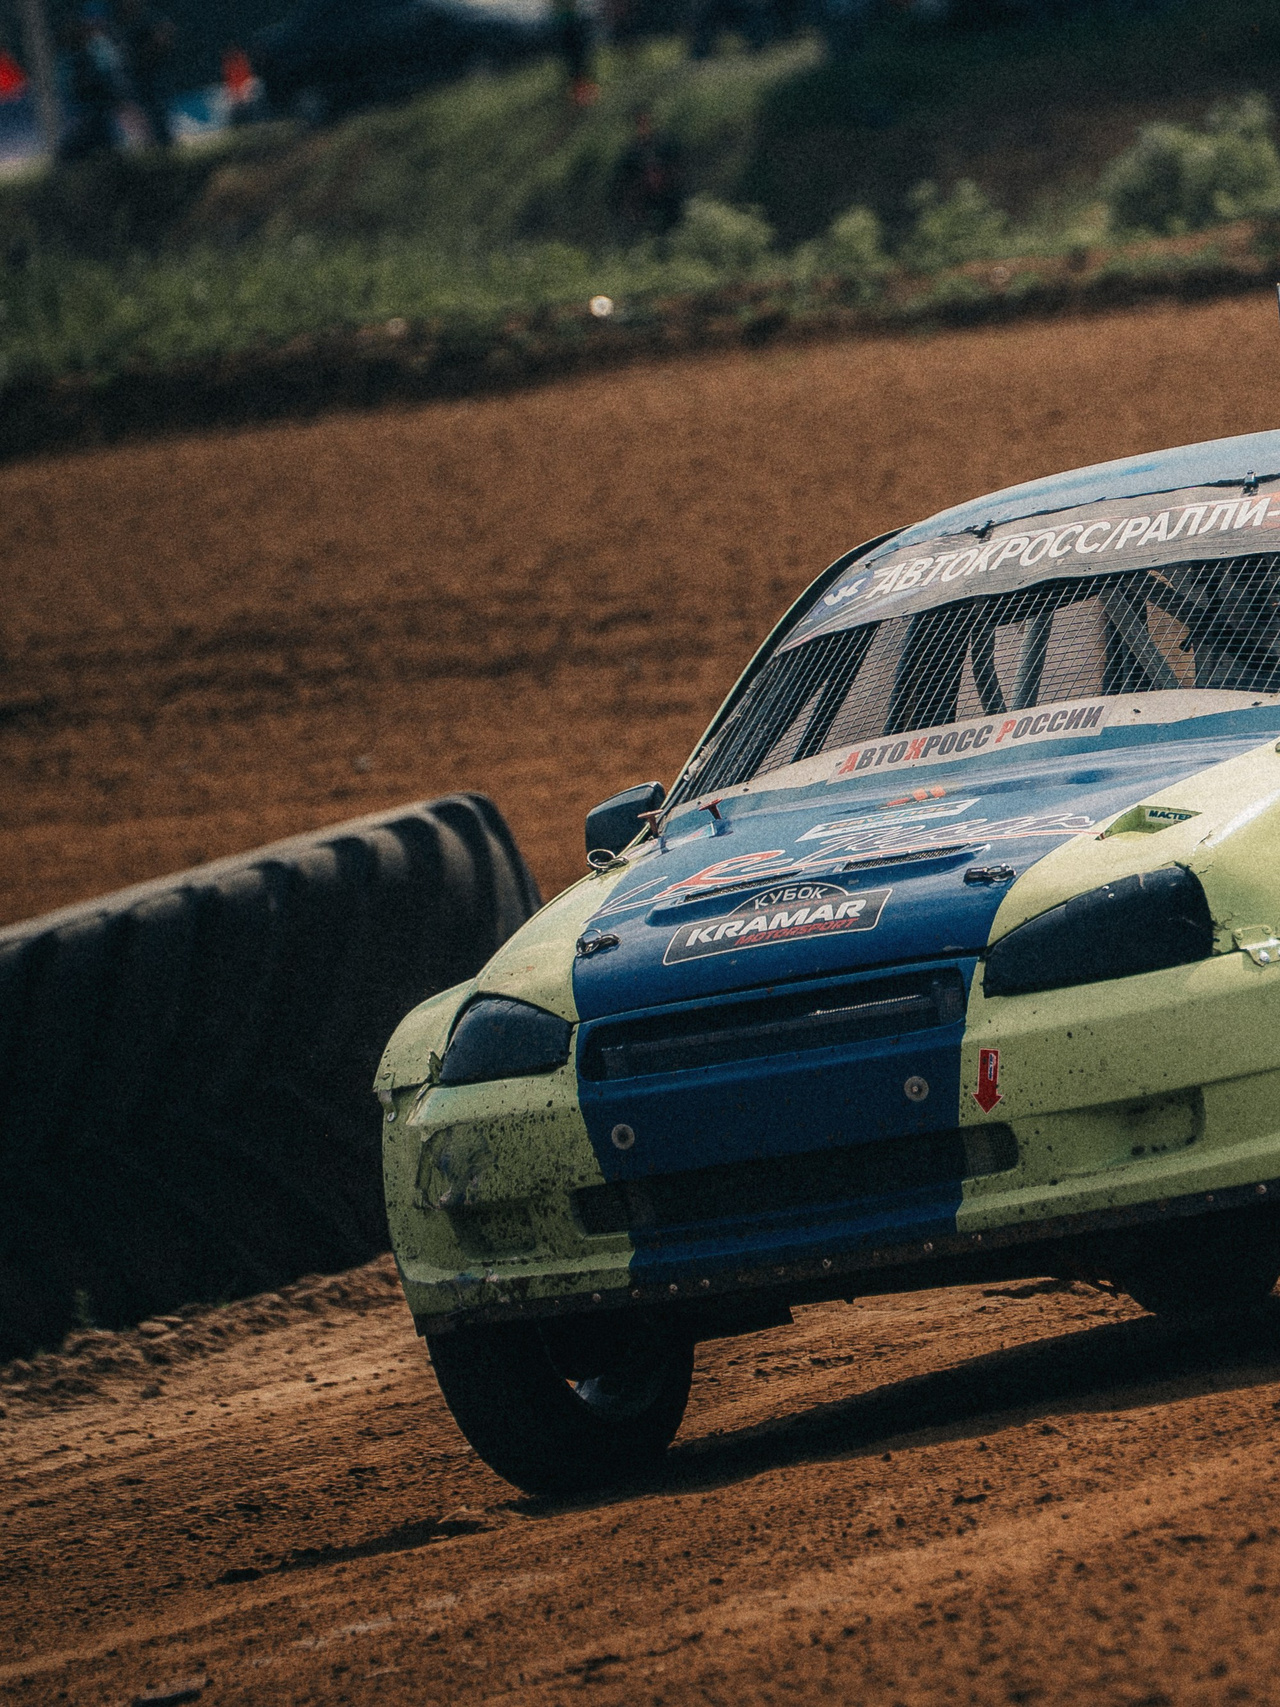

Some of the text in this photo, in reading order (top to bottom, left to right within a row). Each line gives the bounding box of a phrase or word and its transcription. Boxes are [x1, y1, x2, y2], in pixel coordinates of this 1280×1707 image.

[995, 705, 1105, 743] РОССИИ
[754, 886, 829, 910] КУБОК
[685, 899, 867, 947] KRAMAR
[734, 917, 859, 946] MOTORSPORT
